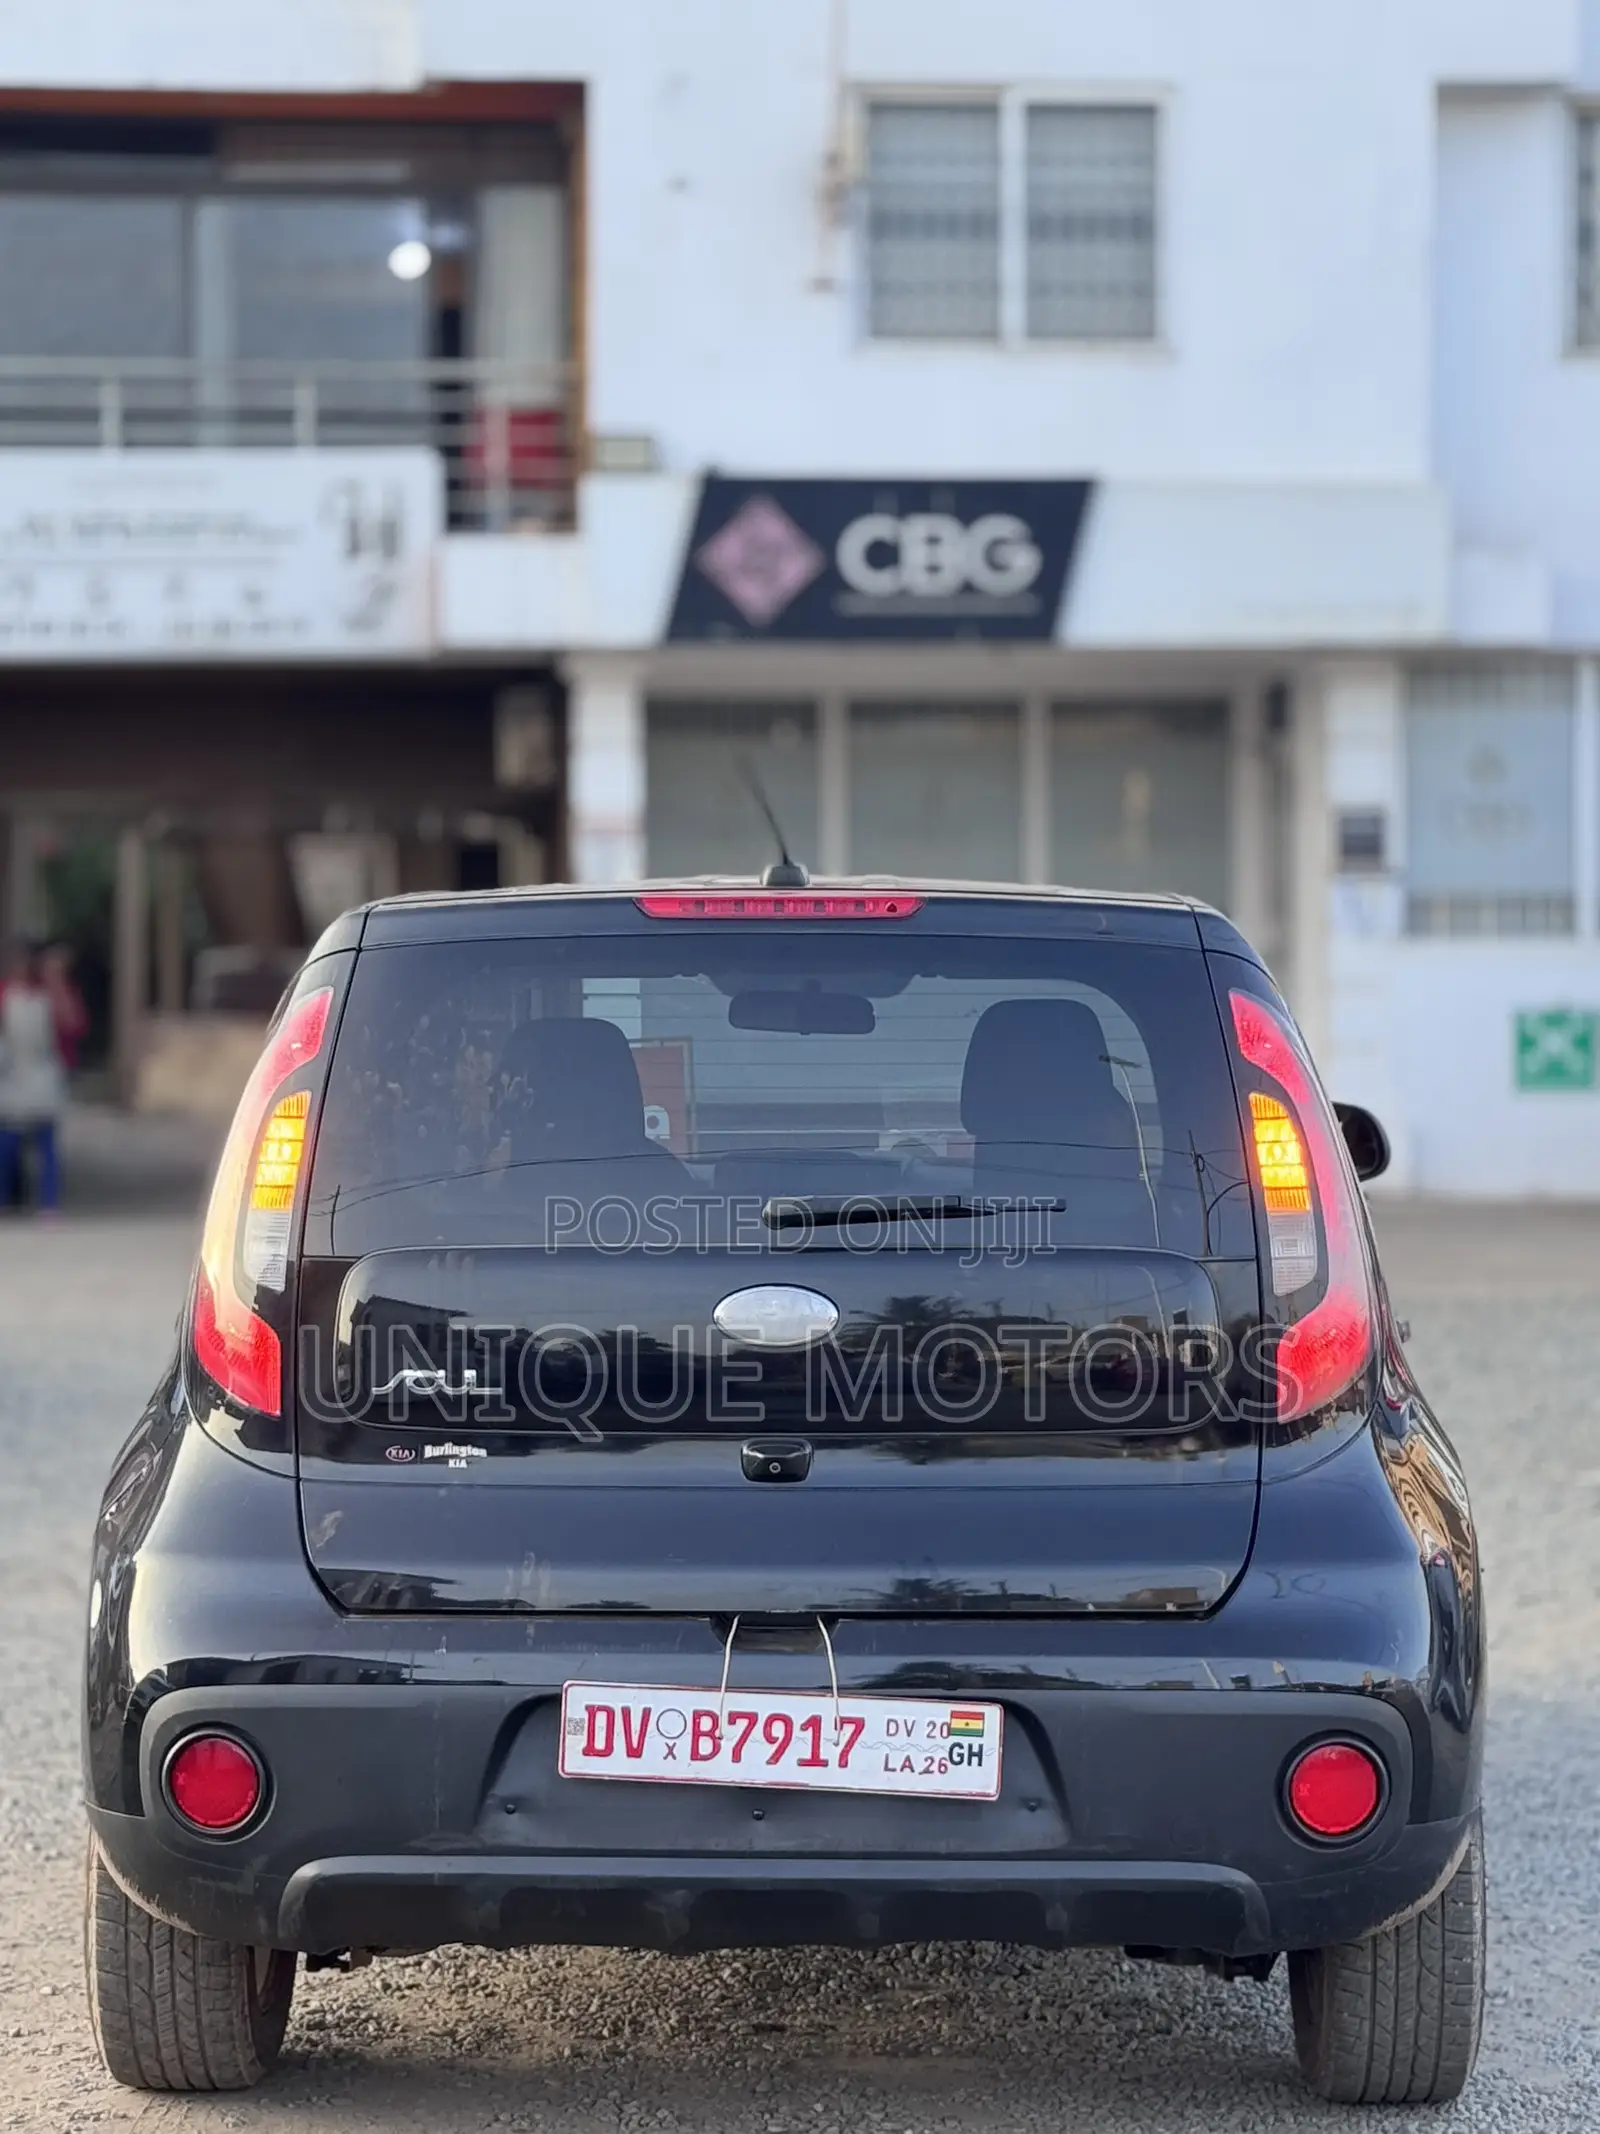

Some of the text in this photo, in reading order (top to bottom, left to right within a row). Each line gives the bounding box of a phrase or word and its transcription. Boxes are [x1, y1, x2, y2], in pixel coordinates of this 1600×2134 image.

[836, 513, 1043, 599] CBG
[424, 1442, 487, 1458] Burlington
[448, 1459, 468, 1469] KIA
[582, 1704, 652, 1758] DV
[690, 1708, 866, 1768] B7917
[886, 1718, 950, 1739] DV 20
[883, 1753, 915, 1773] LA
[949, 1741, 984, 1767] GH
